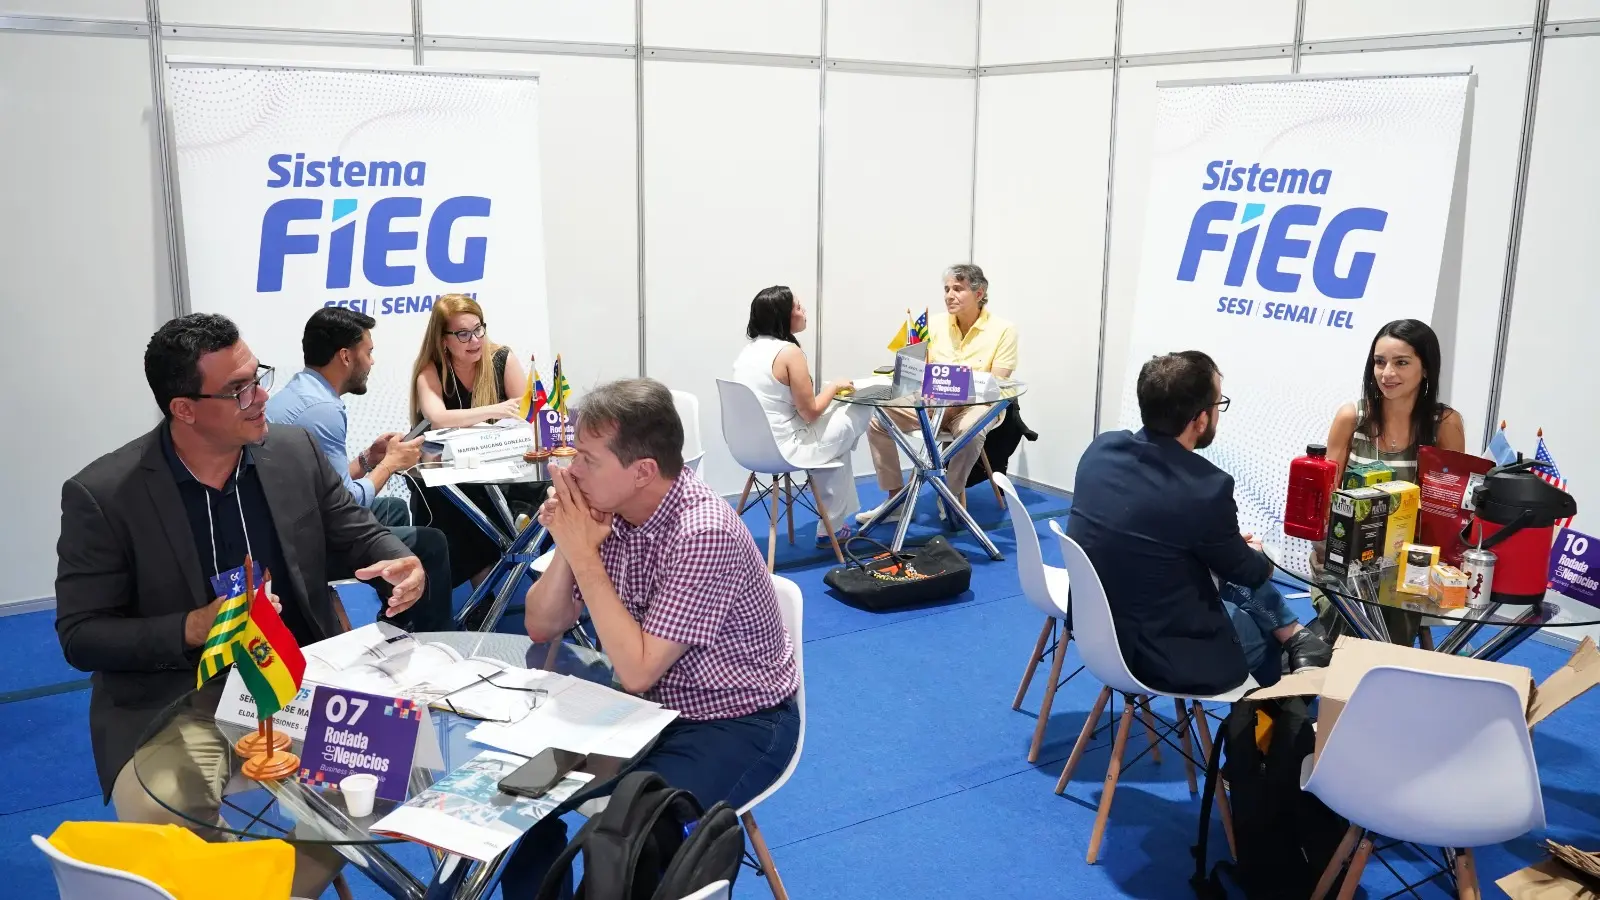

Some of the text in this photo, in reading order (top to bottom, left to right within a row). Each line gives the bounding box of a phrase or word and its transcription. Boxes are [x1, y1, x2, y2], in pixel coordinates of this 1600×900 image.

[267, 153, 426, 188] Sistema
[1202, 160, 1332, 195] Sistema
[1216, 296, 1353, 329] SESI SENAI IEL
[931, 366, 950, 377] 09
[1564, 533, 1588, 556] 10
[1558, 554, 1589, 574] Rodada
[238, 709, 255, 718] ELDA
[325, 694, 369, 726] 07
[324, 727, 369, 749] Rodada
[321, 745, 390, 773] de Negócios
